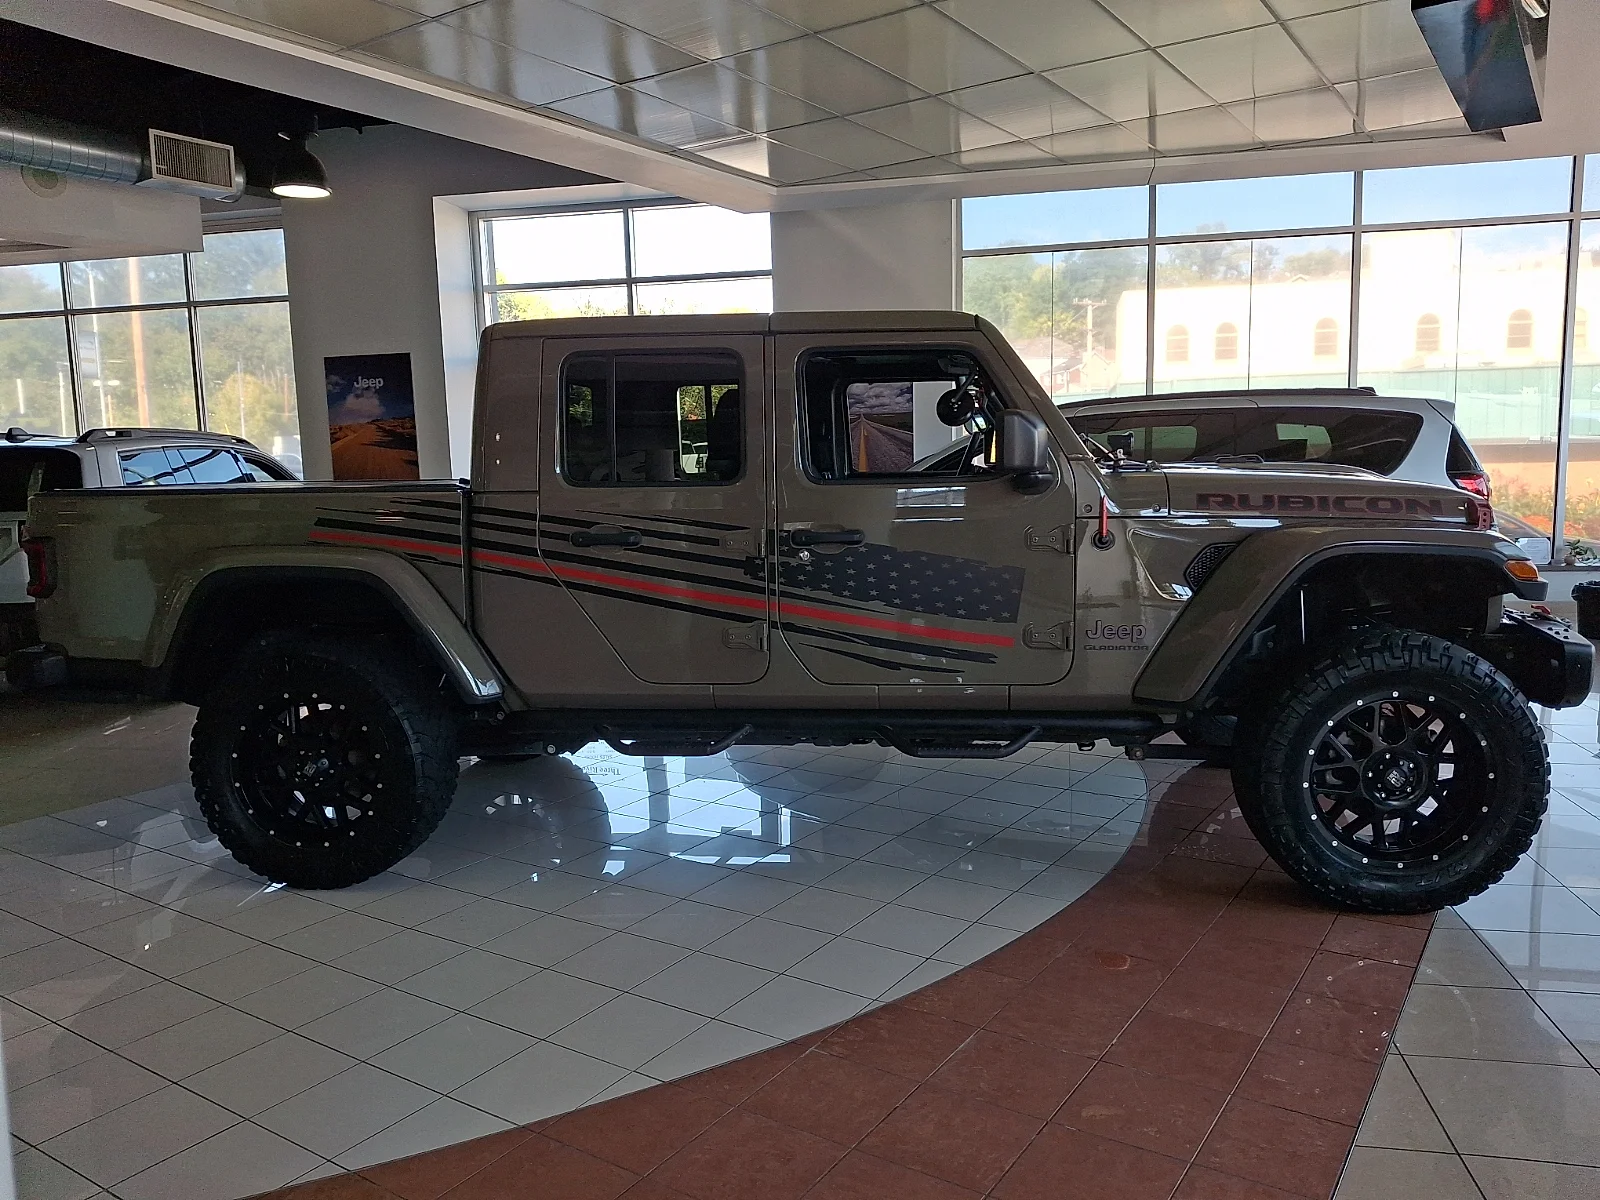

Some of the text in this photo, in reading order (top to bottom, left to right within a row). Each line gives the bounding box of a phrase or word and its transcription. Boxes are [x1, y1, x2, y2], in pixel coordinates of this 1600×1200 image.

[353, 375, 384, 389] Jeep
[1195, 492, 1444, 516] RUBICON
[1085, 619, 1147, 643] Jeep
[600, 766, 621, 776] Three
